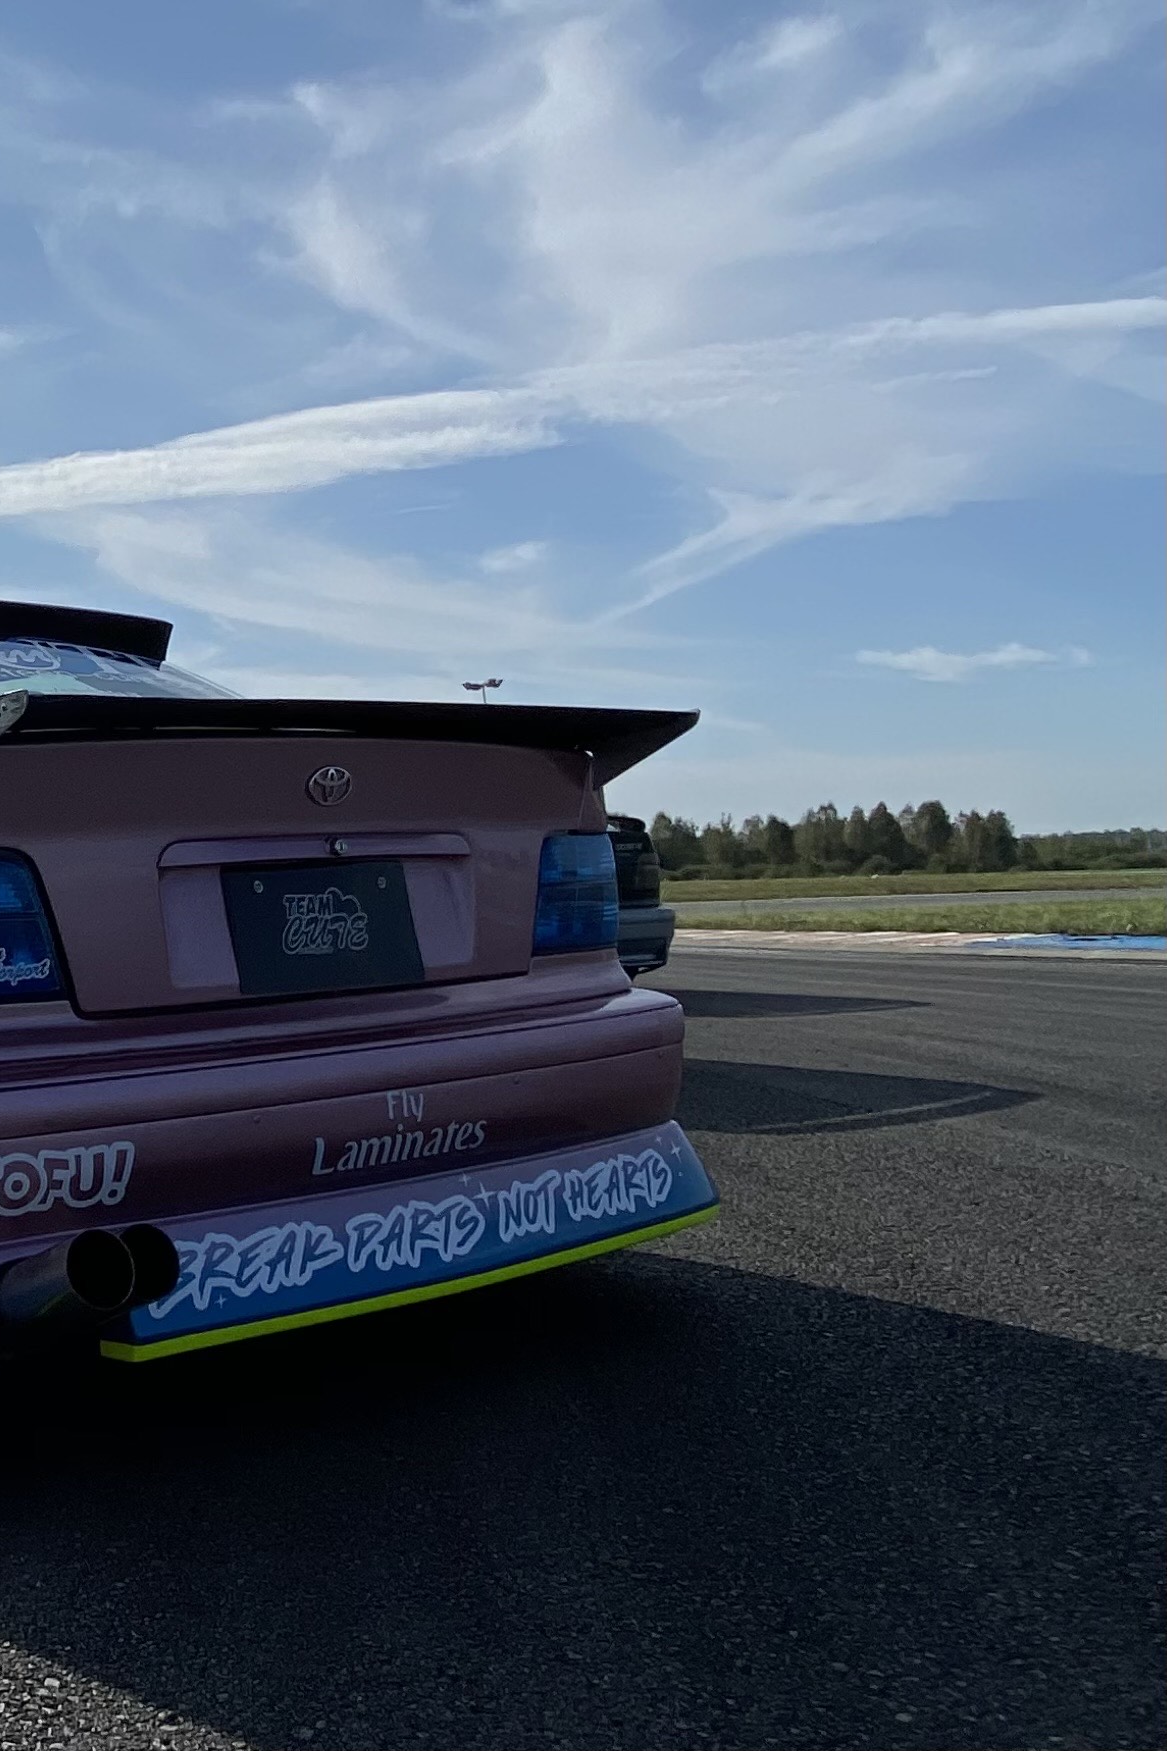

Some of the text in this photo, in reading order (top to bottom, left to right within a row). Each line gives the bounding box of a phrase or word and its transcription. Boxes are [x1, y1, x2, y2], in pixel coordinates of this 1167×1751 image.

[284, 895, 335, 919] TEAM
[387, 1090, 424, 1122] Fly
[312, 1120, 487, 1175] Laminates
[346, 1194, 486, 1272] PARTS
[497, 1169, 561, 1243] NOT
[563, 1149, 672, 1222] HEARTS
